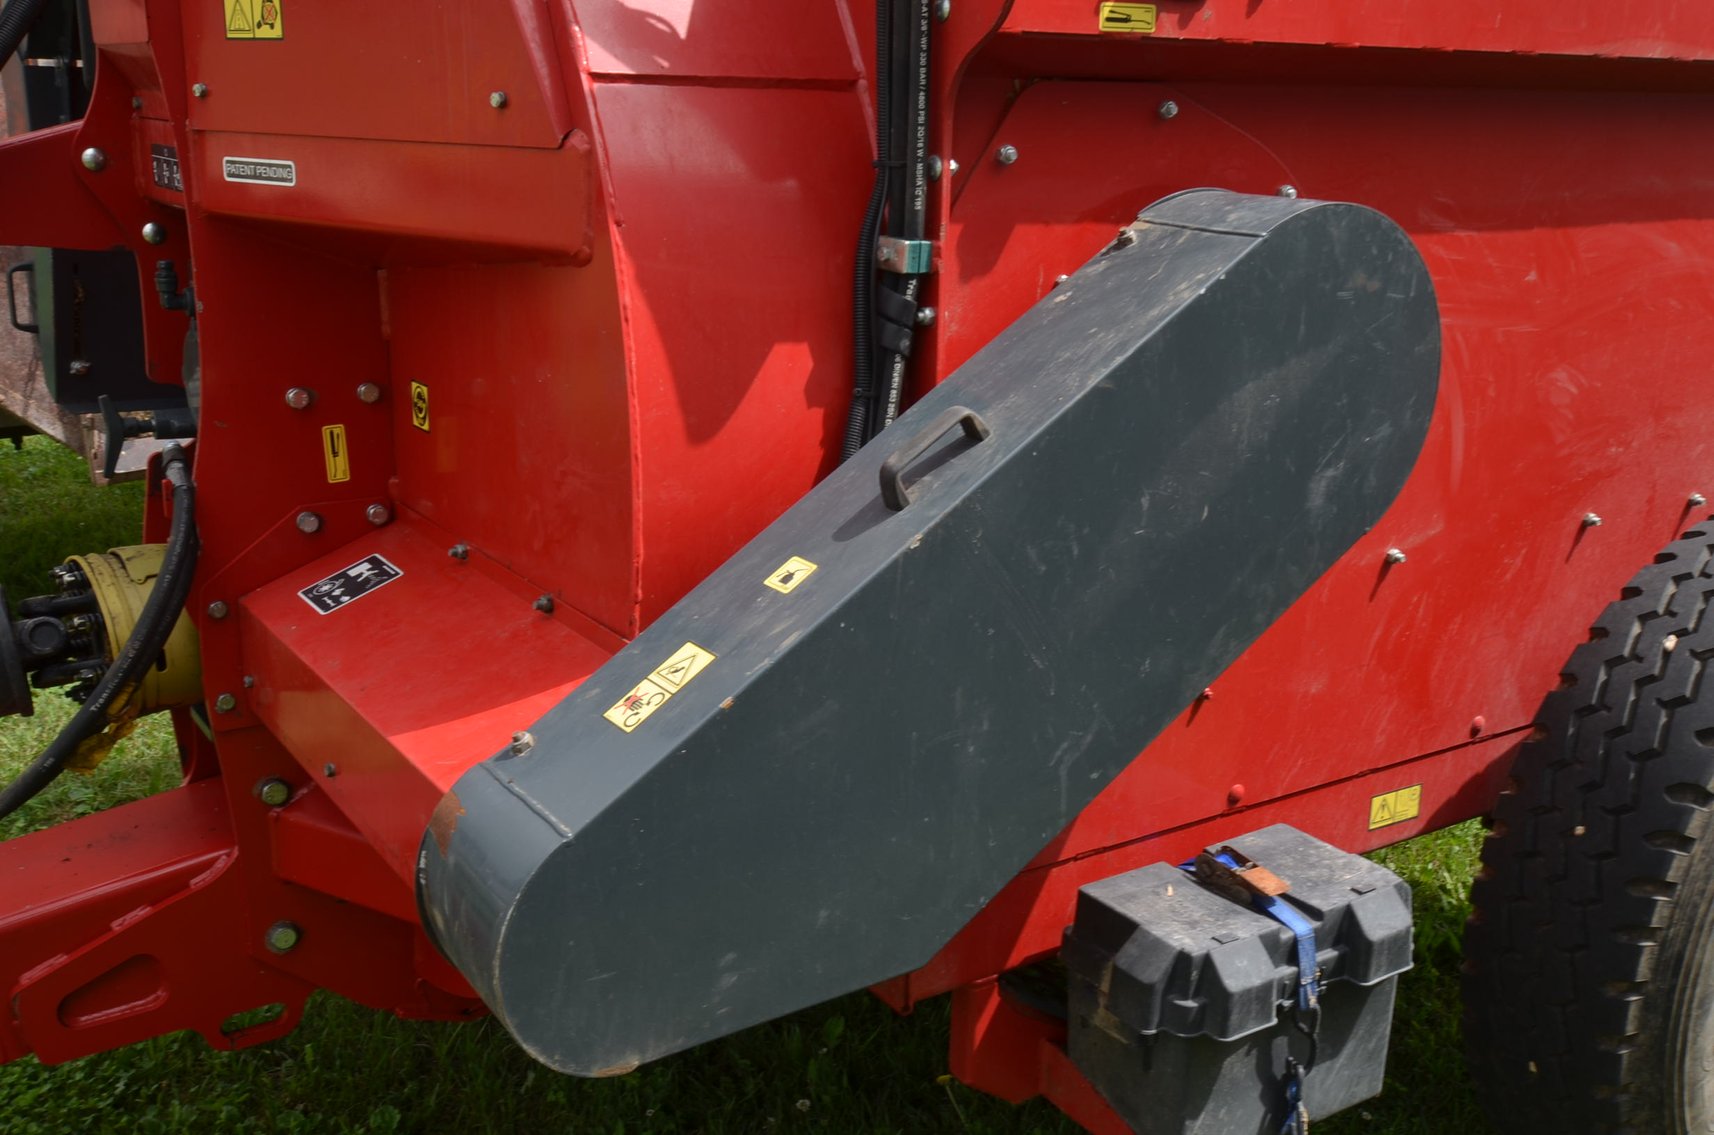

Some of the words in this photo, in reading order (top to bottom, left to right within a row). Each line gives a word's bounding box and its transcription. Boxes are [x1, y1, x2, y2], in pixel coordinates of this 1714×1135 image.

[919, 67, 927, 85] BAR
[917, 110, 925, 124] PSI
[226, 163, 255, 176] PATENT
[256, 165, 292, 179] PENDING
